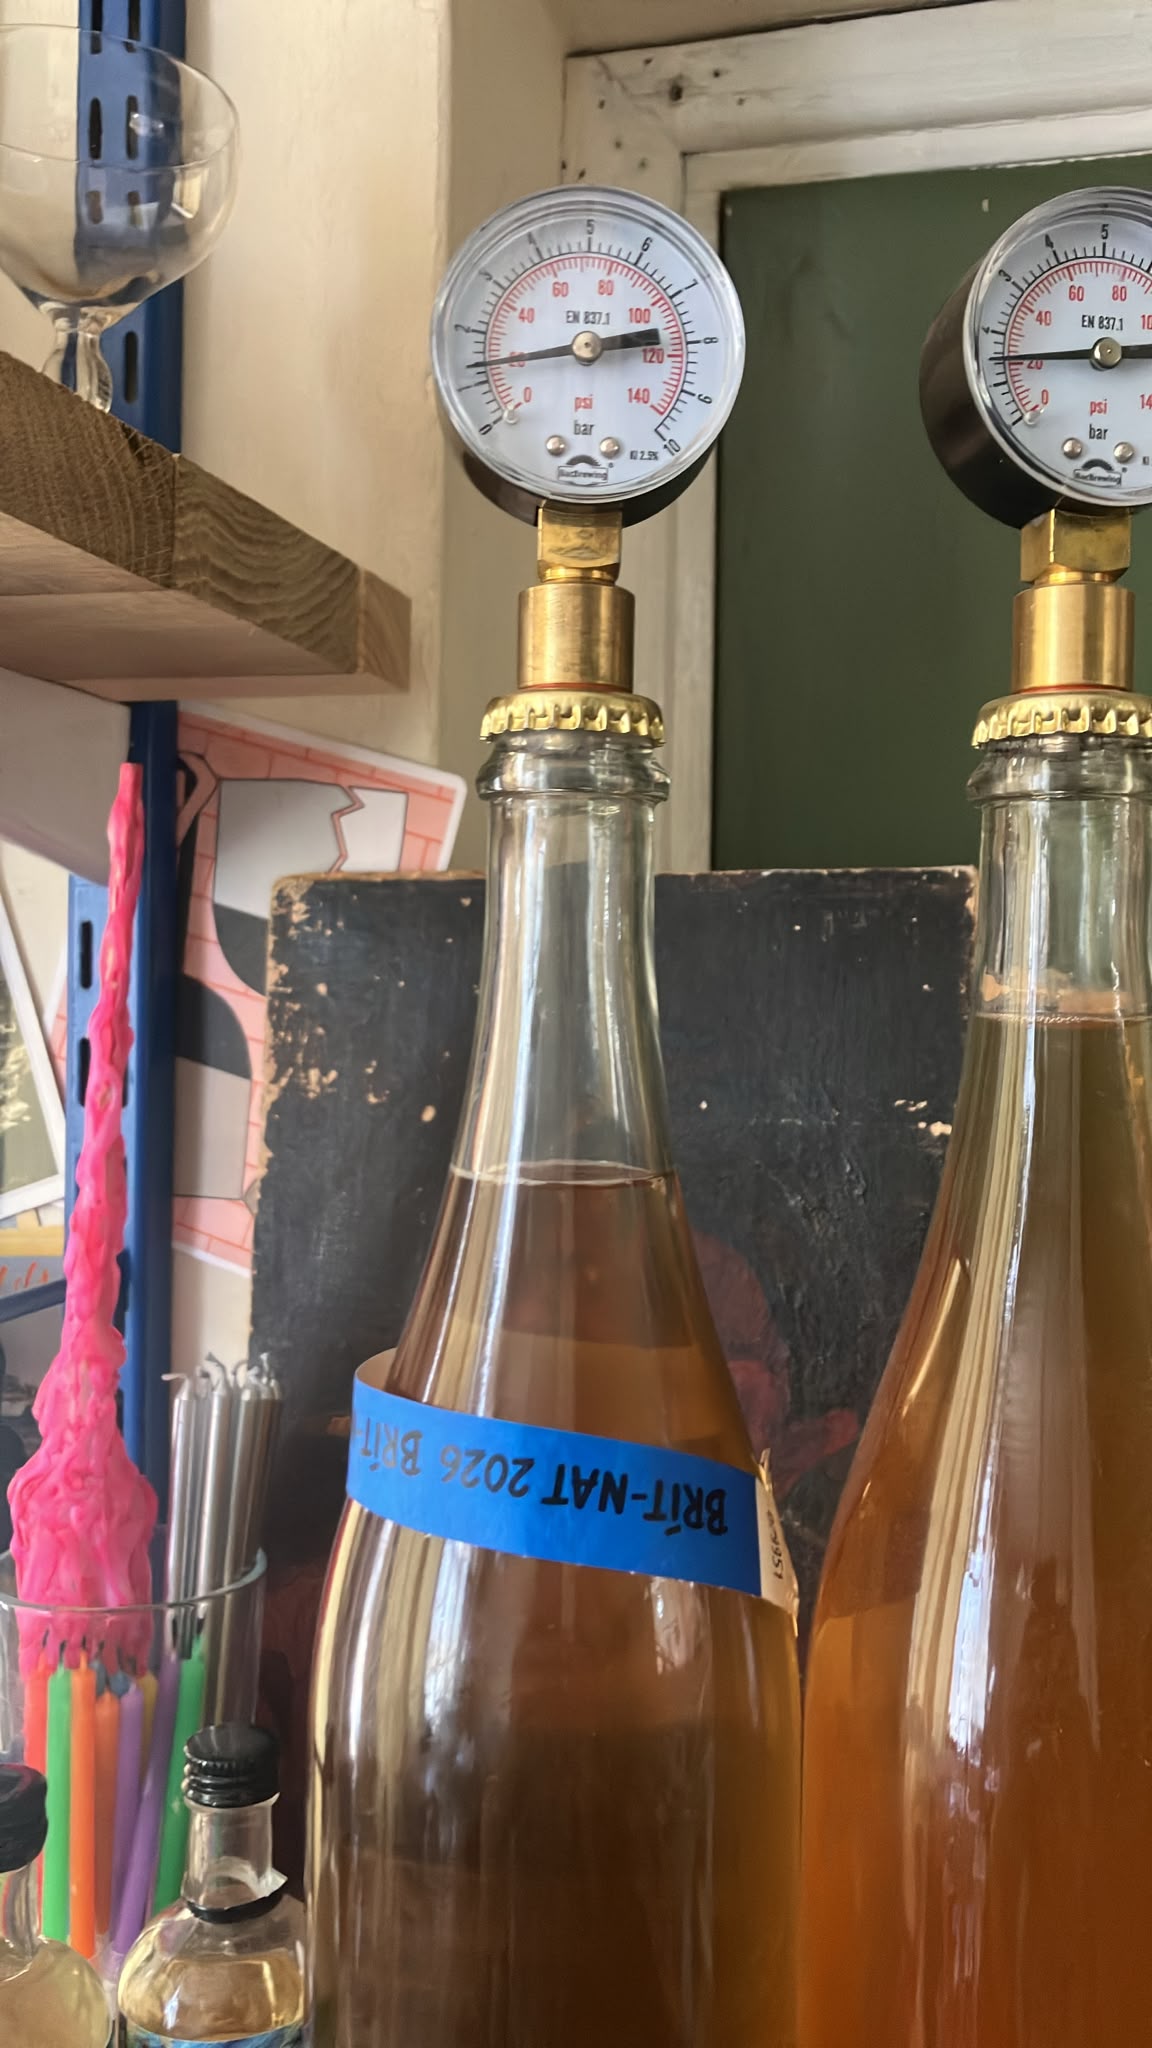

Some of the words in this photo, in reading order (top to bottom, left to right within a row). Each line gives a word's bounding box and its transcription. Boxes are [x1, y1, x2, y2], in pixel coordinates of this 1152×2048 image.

[586, 219, 595, 235] 5
[1100, 224, 1109, 239] 5
[641, 236, 653, 251] 6
[1044, 234, 1055, 248] 4
[998, 269, 1012, 282] 3
[552, 282, 569, 297] 60
[598, 280, 614, 296] 80
[1068, 285, 1085, 302] 60
[1111, 285, 1127, 302] 80
[518, 307, 535, 323] 40
[566, 312, 580, 324] EN
[629, 307, 651, 323] 100
[1035, 310, 1052, 326] 40
[1081, 314, 1095, 328] EN
[1098, 315, 1124, 331] 837.1
[704, 336, 719, 344] 8
[642, 348, 664, 364] 120
[523, 387, 532, 403] 0
[574, 394, 594, 412] psi
[627, 388, 650, 404] 140
[697, 394, 713, 405] 9
[1041, 388, 1050, 404] 0
[1089, 399, 1108, 416] psi
[479, 423, 493, 436] 0
[574, 420, 595, 436] bar
[1089, 425, 1109, 440] bar
[662, 439, 682, 457] 10
[440, 1442, 535, 1498] 2026
